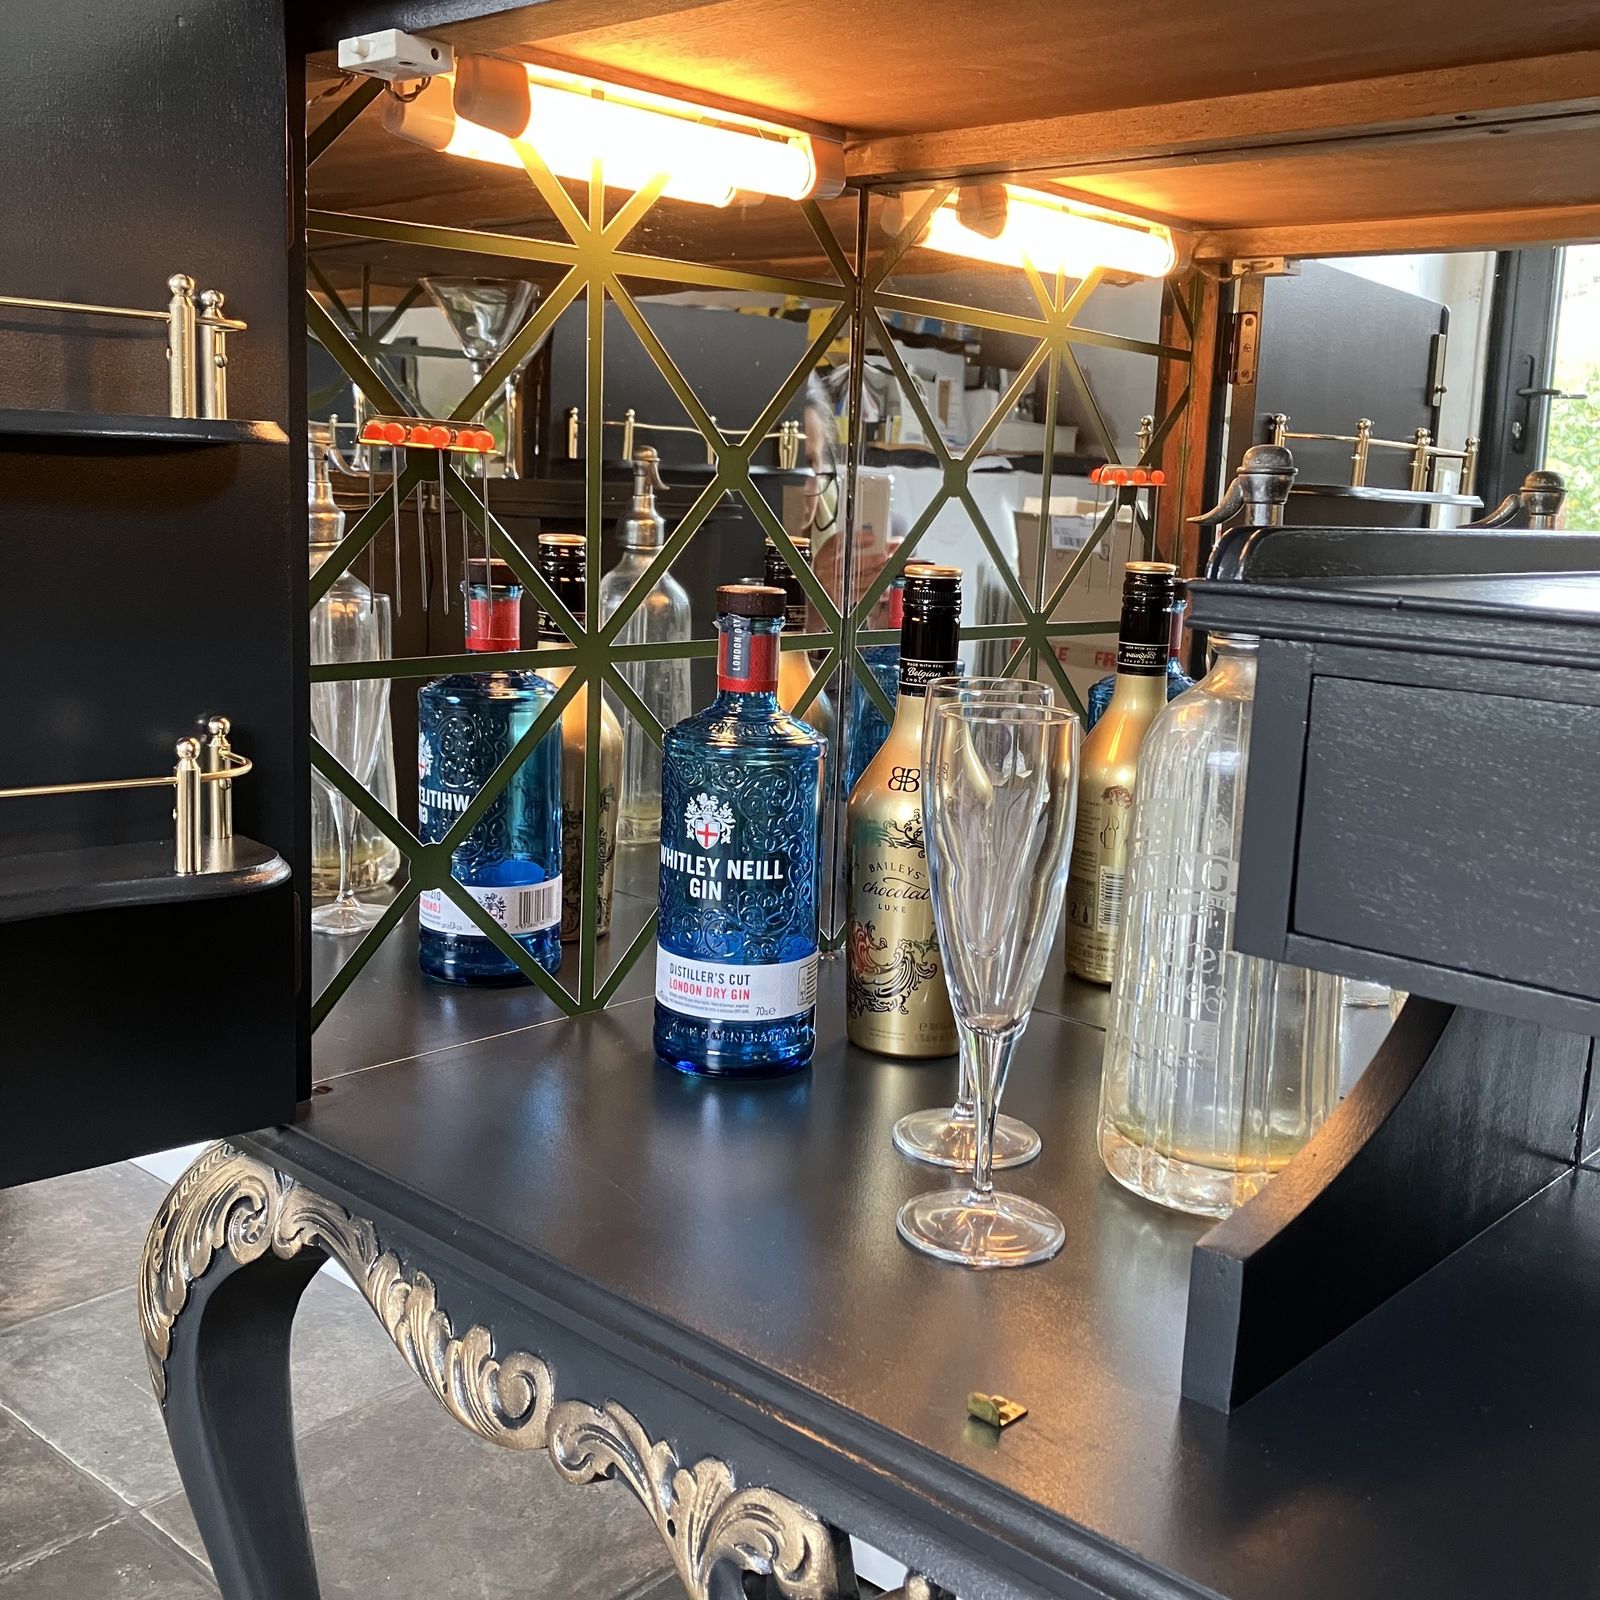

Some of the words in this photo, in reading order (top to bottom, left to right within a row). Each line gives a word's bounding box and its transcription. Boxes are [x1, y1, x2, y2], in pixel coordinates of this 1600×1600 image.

[732, 618, 742, 635] DRY
[732, 636, 742, 671] LONDON
[907, 666, 942, 679] Belgian
[660, 844, 721, 878] WHITLEY
[726, 859, 784, 880] NEILL
[868, 862, 922, 880] BAILEYS
[689, 878, 723, 901] GIN
[862, 877, 931, 901] chocolat
[877, 903, 907, 914] LUXE
[669, 963, 725, 985] DISTILLER'S
[729, 974, 751, 986] CUT
[669, 978, 702, 996] LONDON
[705, 986, 727, 1000] DRY
[730, 989, 750, 1001] GIN
